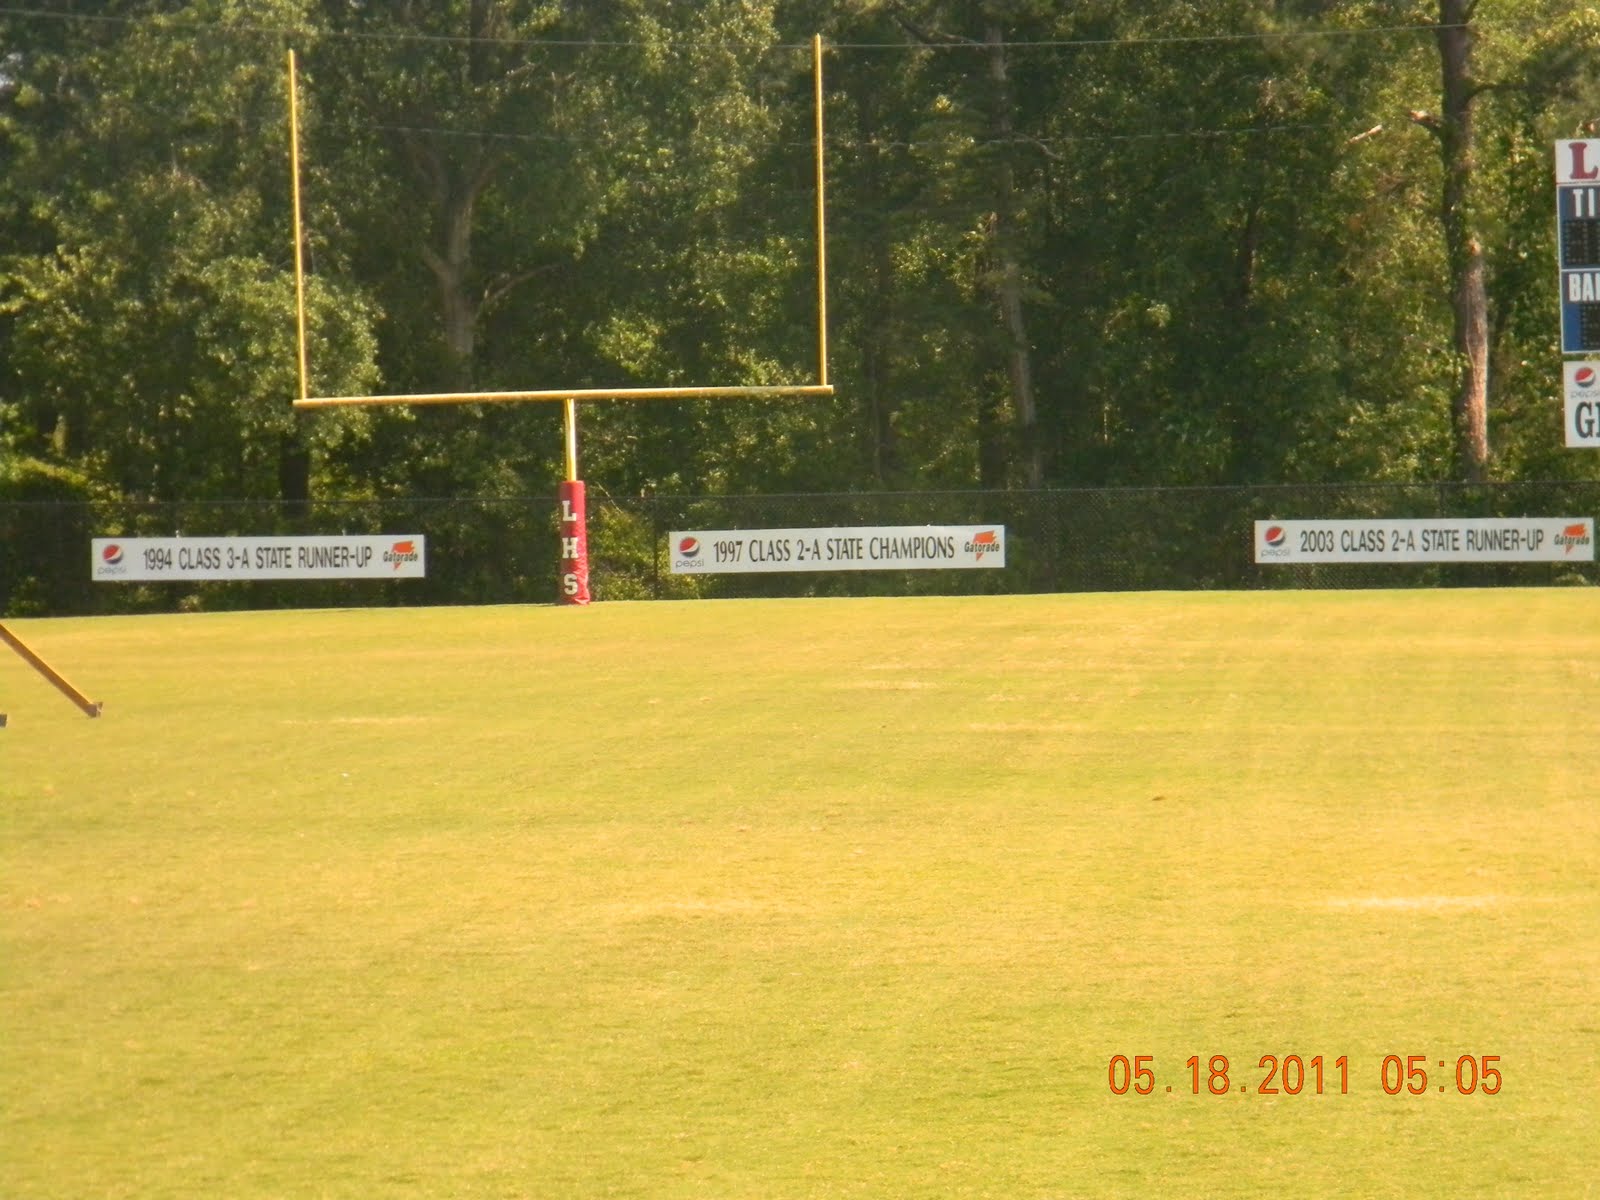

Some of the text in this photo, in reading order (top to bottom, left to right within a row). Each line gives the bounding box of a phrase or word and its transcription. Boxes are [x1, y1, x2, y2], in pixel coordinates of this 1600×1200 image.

[1568, 142, 1599, 180] L
[964, 541, 1000, 553] Gatorade
[1300, 528, 1544, 553] 2003 CLASS 2-A STATE RUNNER-UP
[1554, 533, 1590, 546] Gatorade
[143, 546, 373, 570] 1994 CLASS 3-A STATE RUNNER-UP
[383, 551, 419, 563] Gatorade
[713, 536, 955, 563] 1997 CLASS 2-A STATE CHAMPIONS
[675, 557, 705, 568] pepsi
